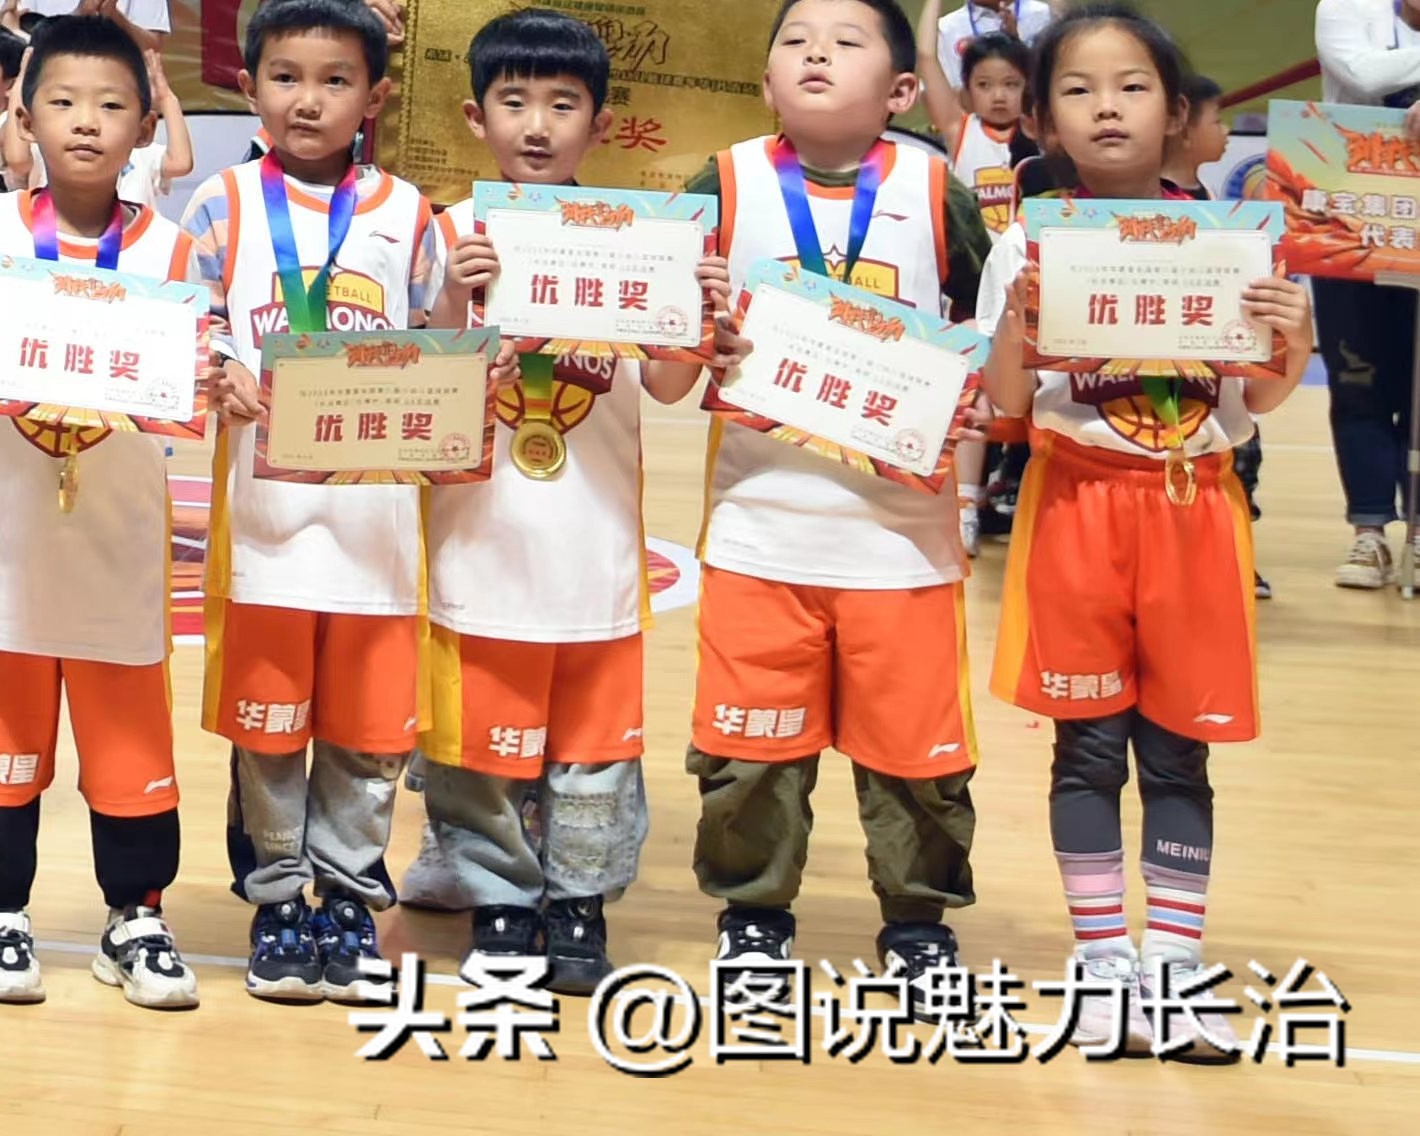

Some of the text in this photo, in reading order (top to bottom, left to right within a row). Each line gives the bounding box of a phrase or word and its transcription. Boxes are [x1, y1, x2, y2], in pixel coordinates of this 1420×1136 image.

[530, 273, 650, 312] 优胜奖
[1088, 293, 1215, 328] 优胜奖
[19, 336, 141, 382] 优胜奖
[773, 357, 900, 427] 优胜奖
[314, 412, 434, 443] 优胜奖
[1041, 669, 1123, 701] 华蒙星
[712, 702, 807, 739] 华蒙星
